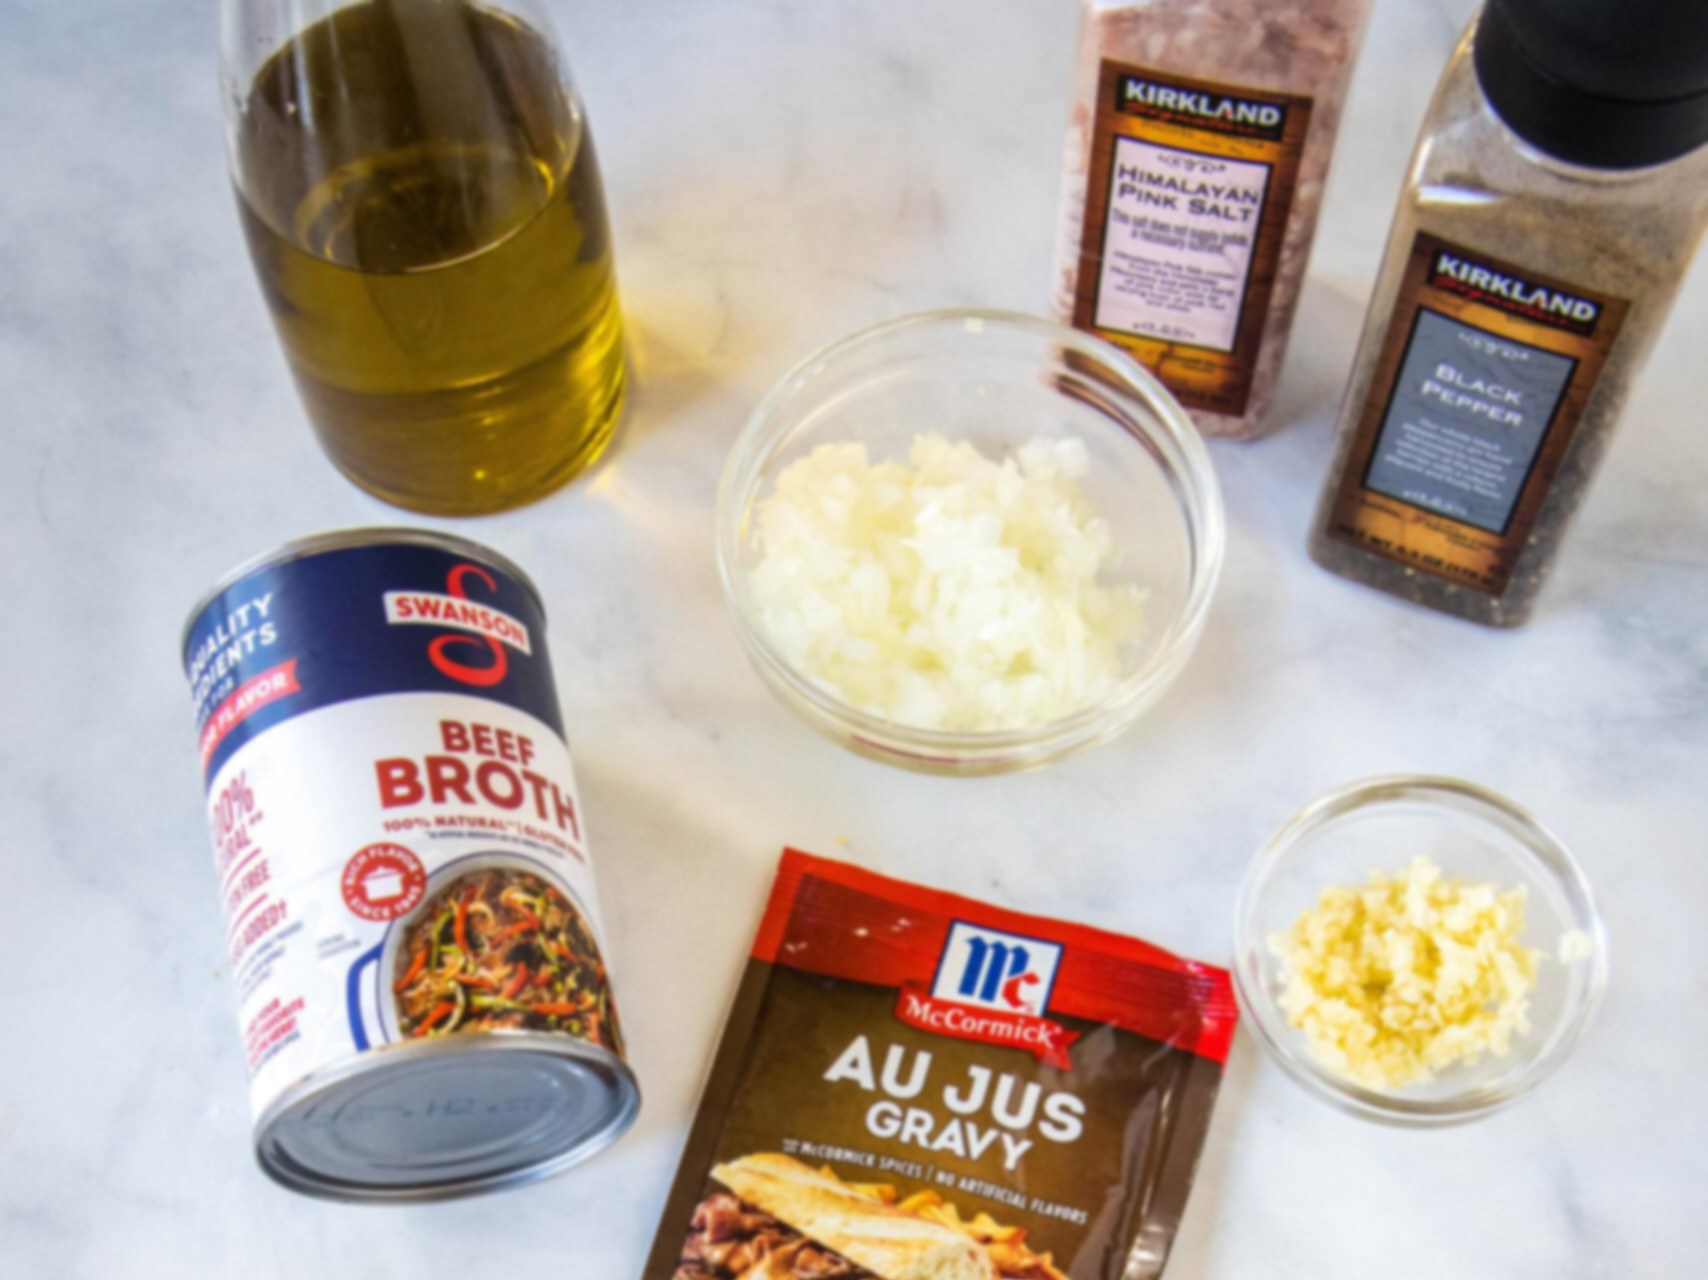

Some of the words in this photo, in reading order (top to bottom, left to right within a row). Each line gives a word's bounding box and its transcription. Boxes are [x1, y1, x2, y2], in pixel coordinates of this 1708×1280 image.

[1125, 78, 1281, 128] KIRKLAND
[1436, 252, 1597, 322] KIRKLAND
[1421, 380, 1525, 427] PEPPER
[1435, 362, 1523, 404] BLACK
[395, 595, 527, 647] SWANSON
[217, 671, 288, 728] FLAVOR
[438, 719, 535, 767] BEEF
[374, 754, 582, 842] BROTH
[382, 816, 431, 833] 100%
[823, 1034, 932, 1100] AU
[942, 1063, 1087, 1143] JUS
[864, 1100, 1033, 1172] GRAVY
[800, 1142, 876, 1168] McCORMICK
[879, 1153, 923, 1179] SPICES
[935, 1170, 956, 1187] NO
[957, 1177, 1029, 1211] ARTIFICIAL
[1029, 1197, 1089, 1225] FLAVORS
